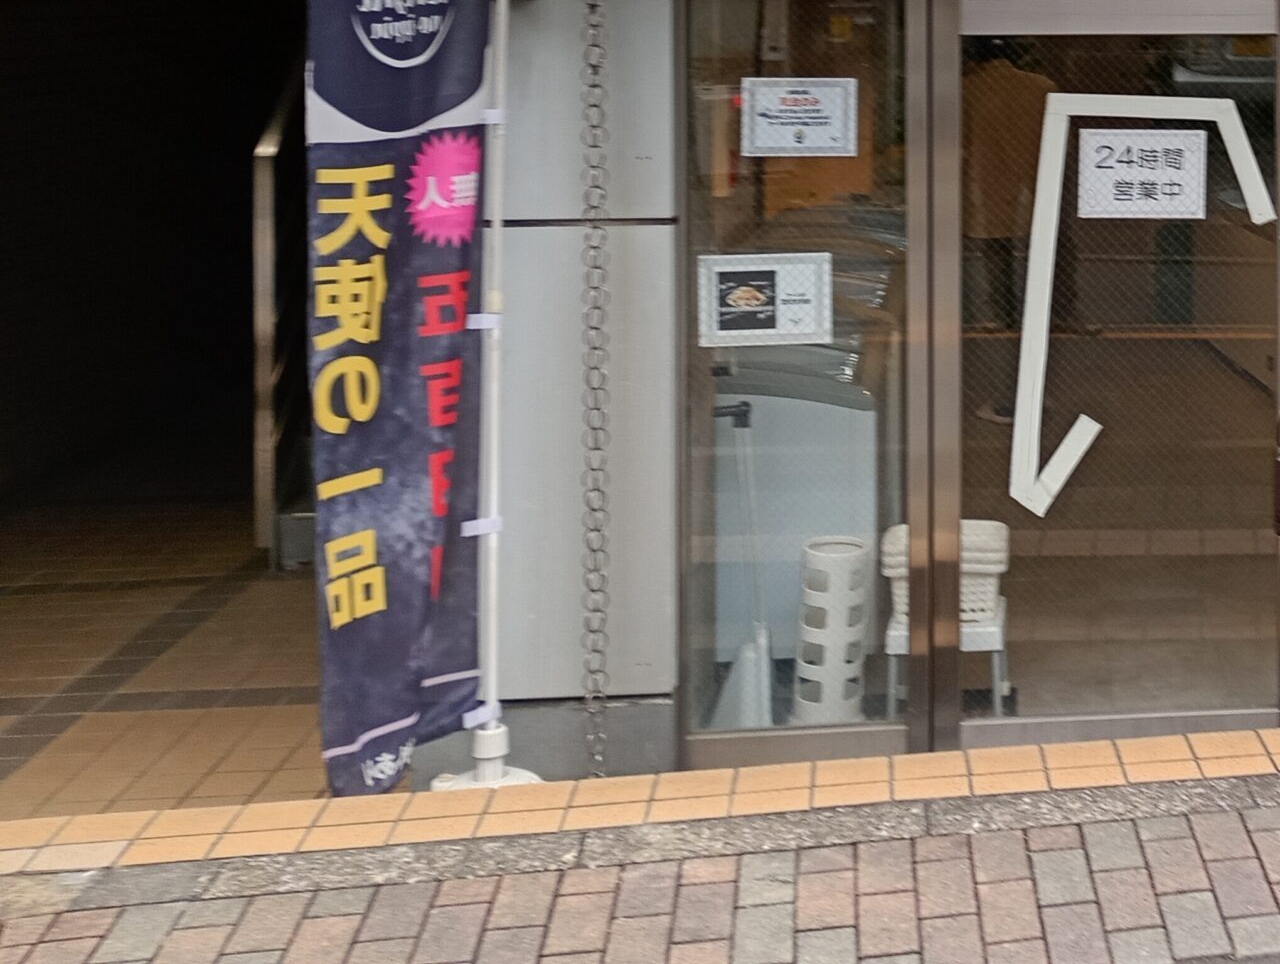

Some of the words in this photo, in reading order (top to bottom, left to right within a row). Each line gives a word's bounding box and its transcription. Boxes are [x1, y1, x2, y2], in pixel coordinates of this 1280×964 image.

[1094, 145, 1185, 171] 24時間
[1112, 179, 1184, 202] 営業中
